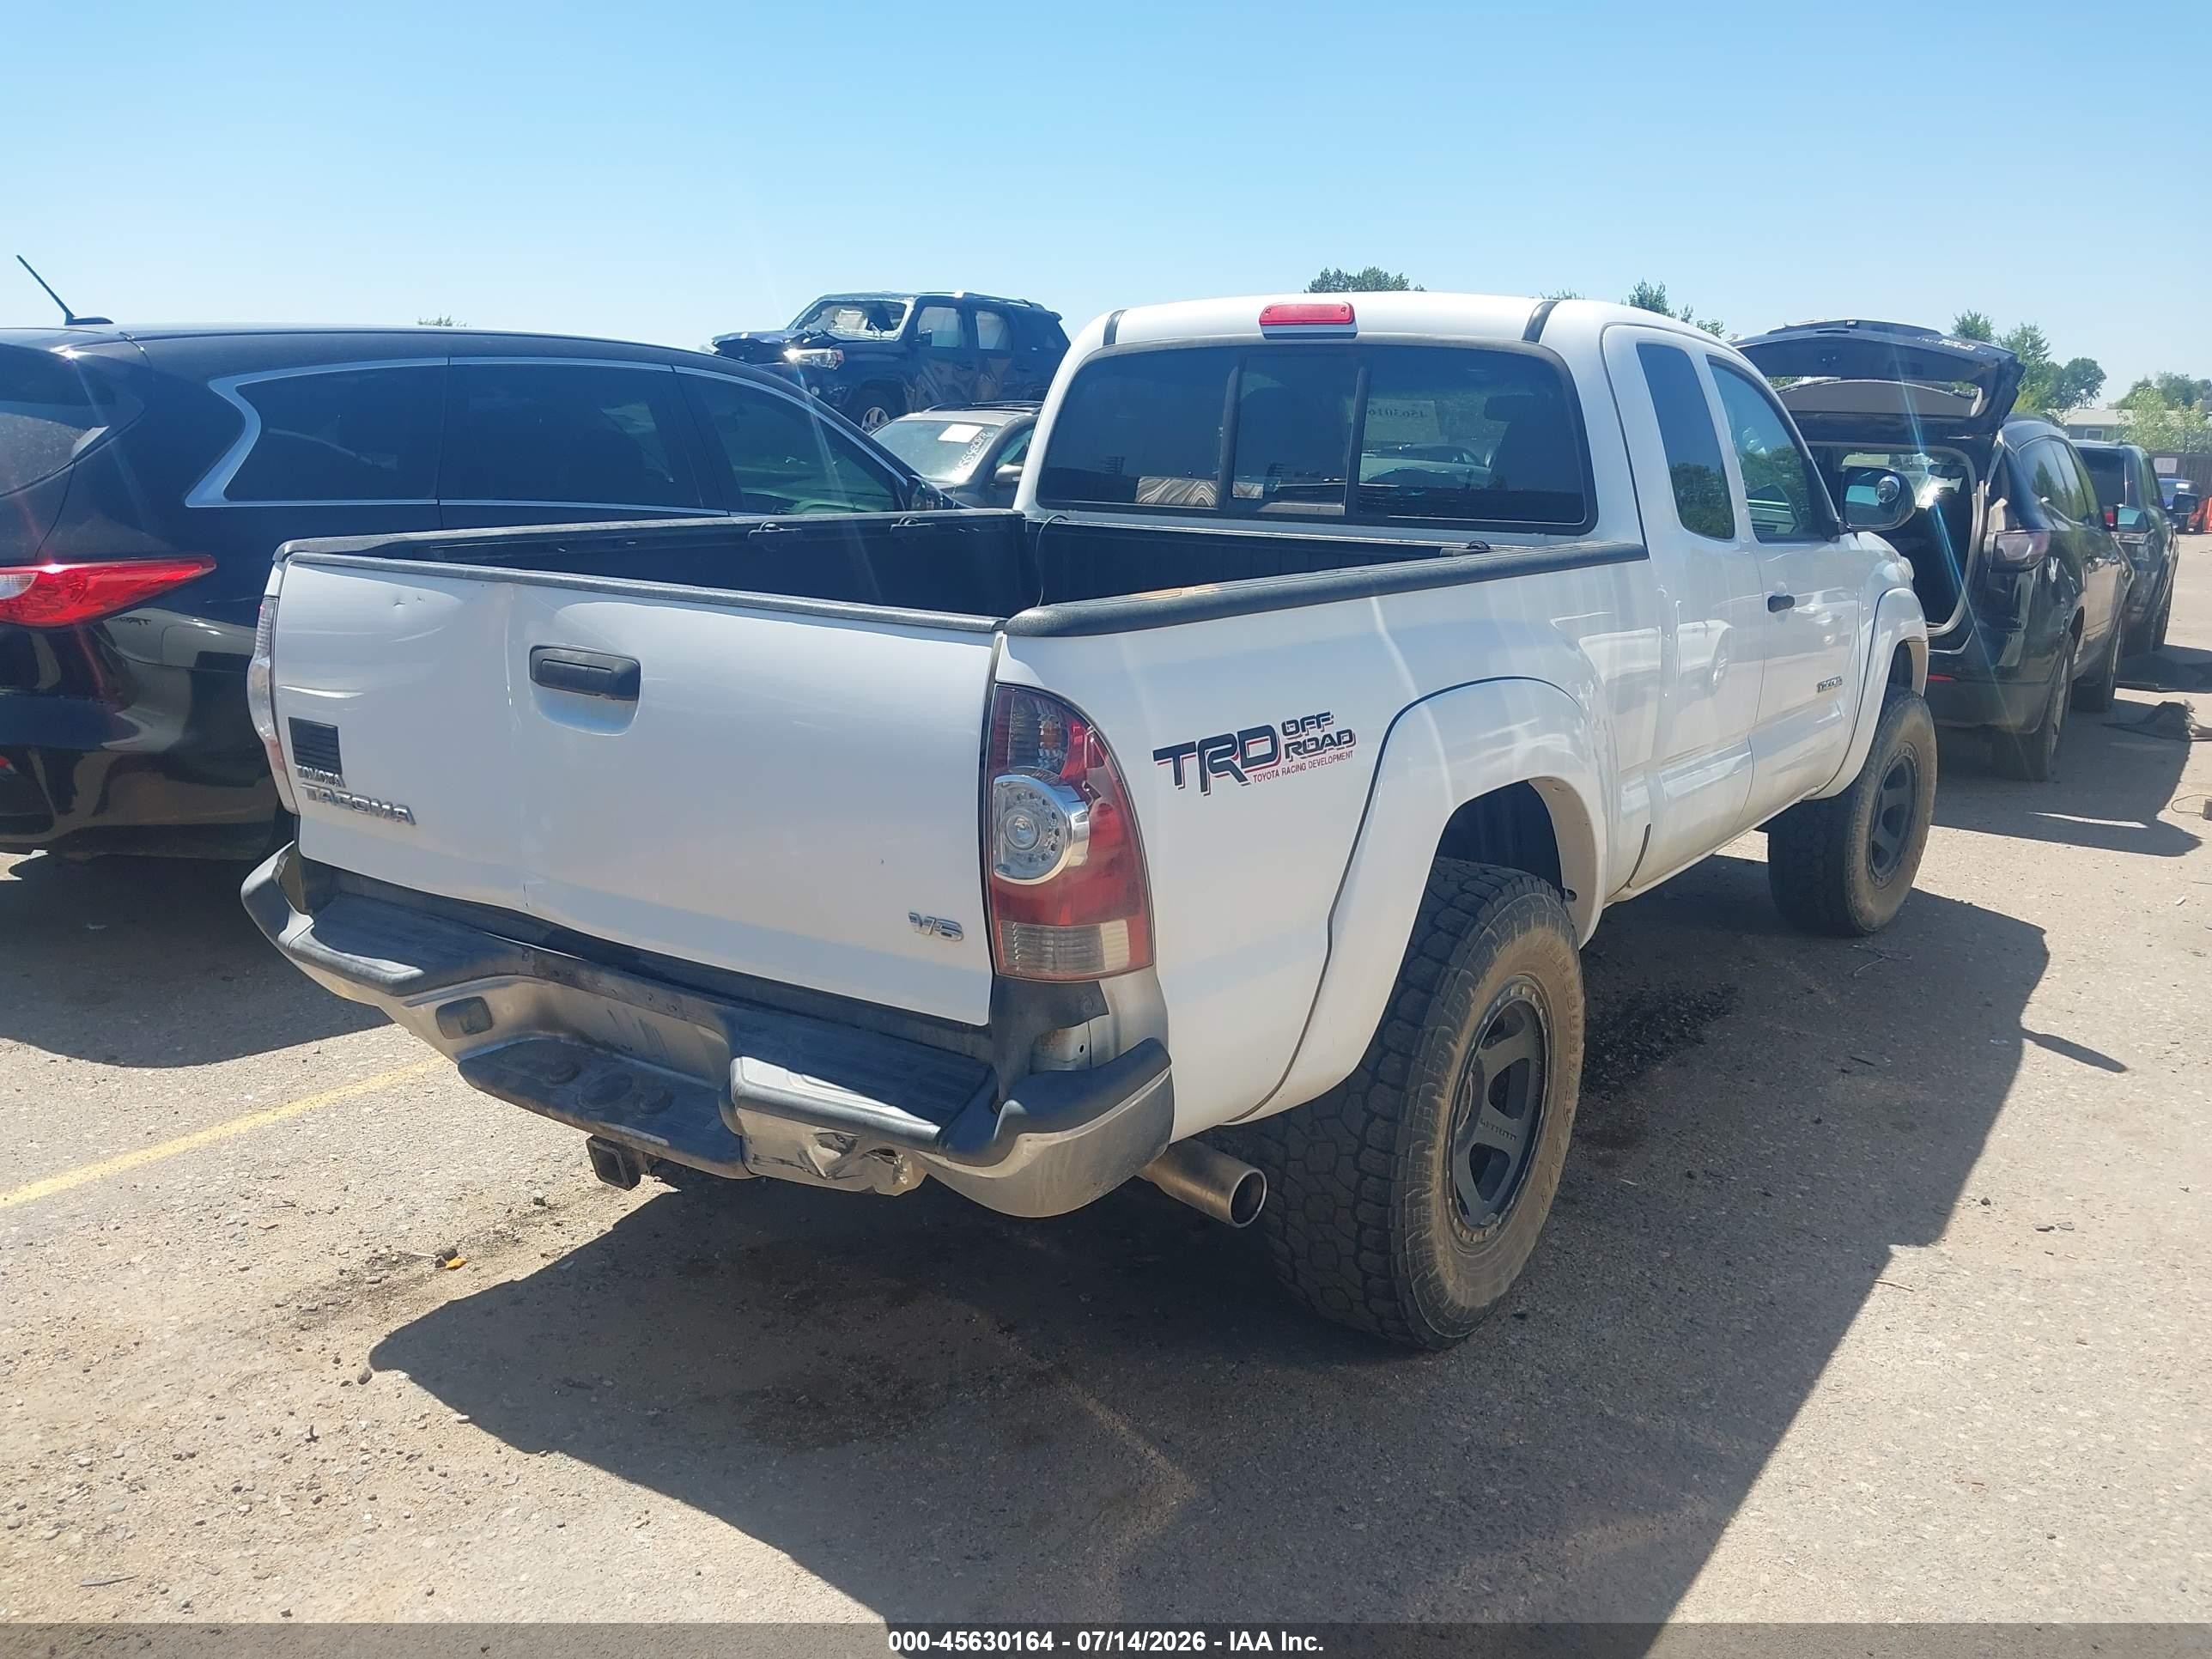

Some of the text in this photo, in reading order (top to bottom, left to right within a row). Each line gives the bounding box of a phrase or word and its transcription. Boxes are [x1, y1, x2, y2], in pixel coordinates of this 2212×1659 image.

[1281, 711, 1334, 739] OFF
[1152, 724, 1281, 796] TRD
[1284, 729, 1357, 763] ROAD
[295, 764, 346, 788] TOYOTA
[1253, 750, 1354, 783] TOYOTA RACING DEVELOPMENT
[300, 782, 416, 825] TACOMA
[908, 912, 964, 942] V6
